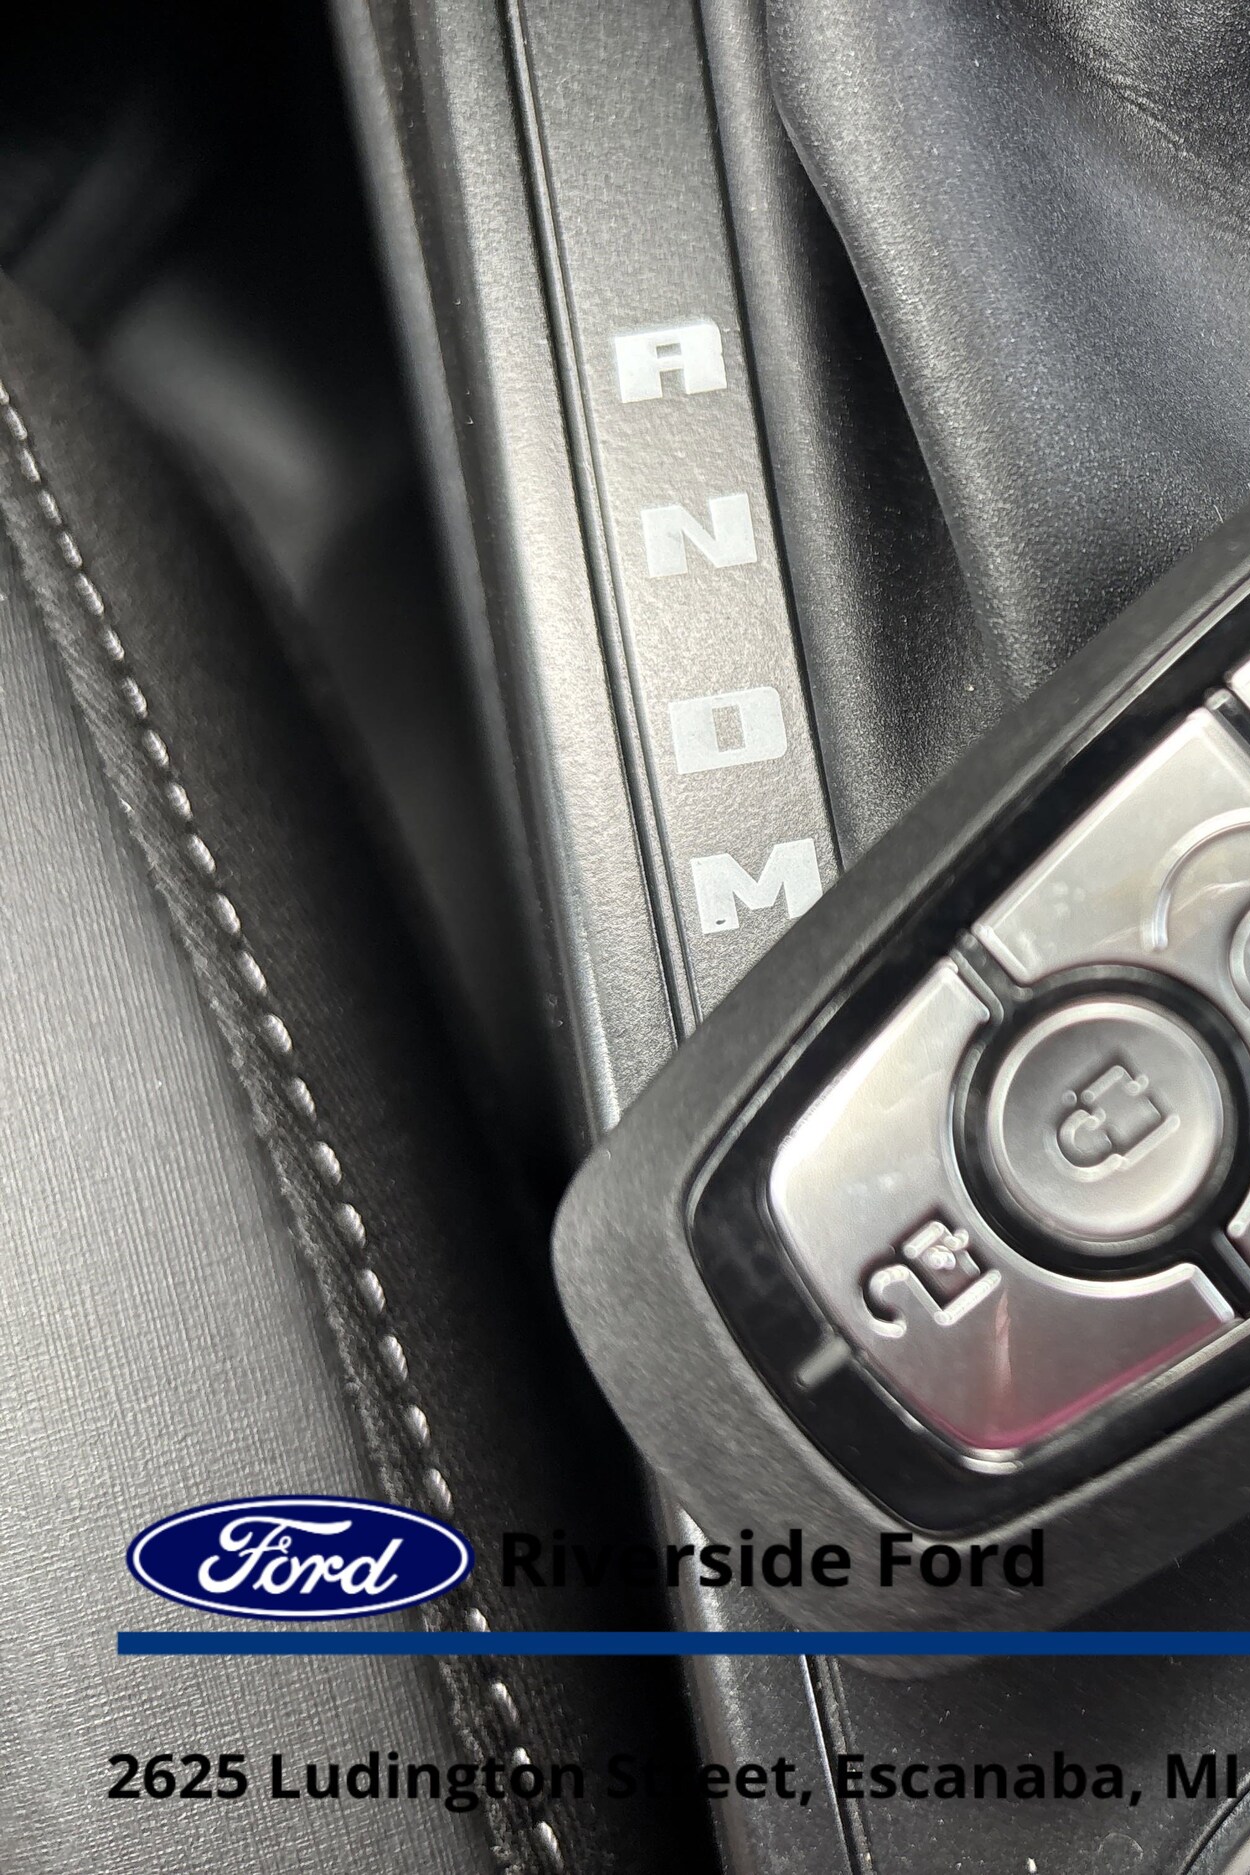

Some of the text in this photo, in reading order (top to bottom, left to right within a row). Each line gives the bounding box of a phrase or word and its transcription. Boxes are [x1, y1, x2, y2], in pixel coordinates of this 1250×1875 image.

[640, 493, 758, 578] N
[668, 685, 788, 774] D
[690, 838, 824, 934] M
